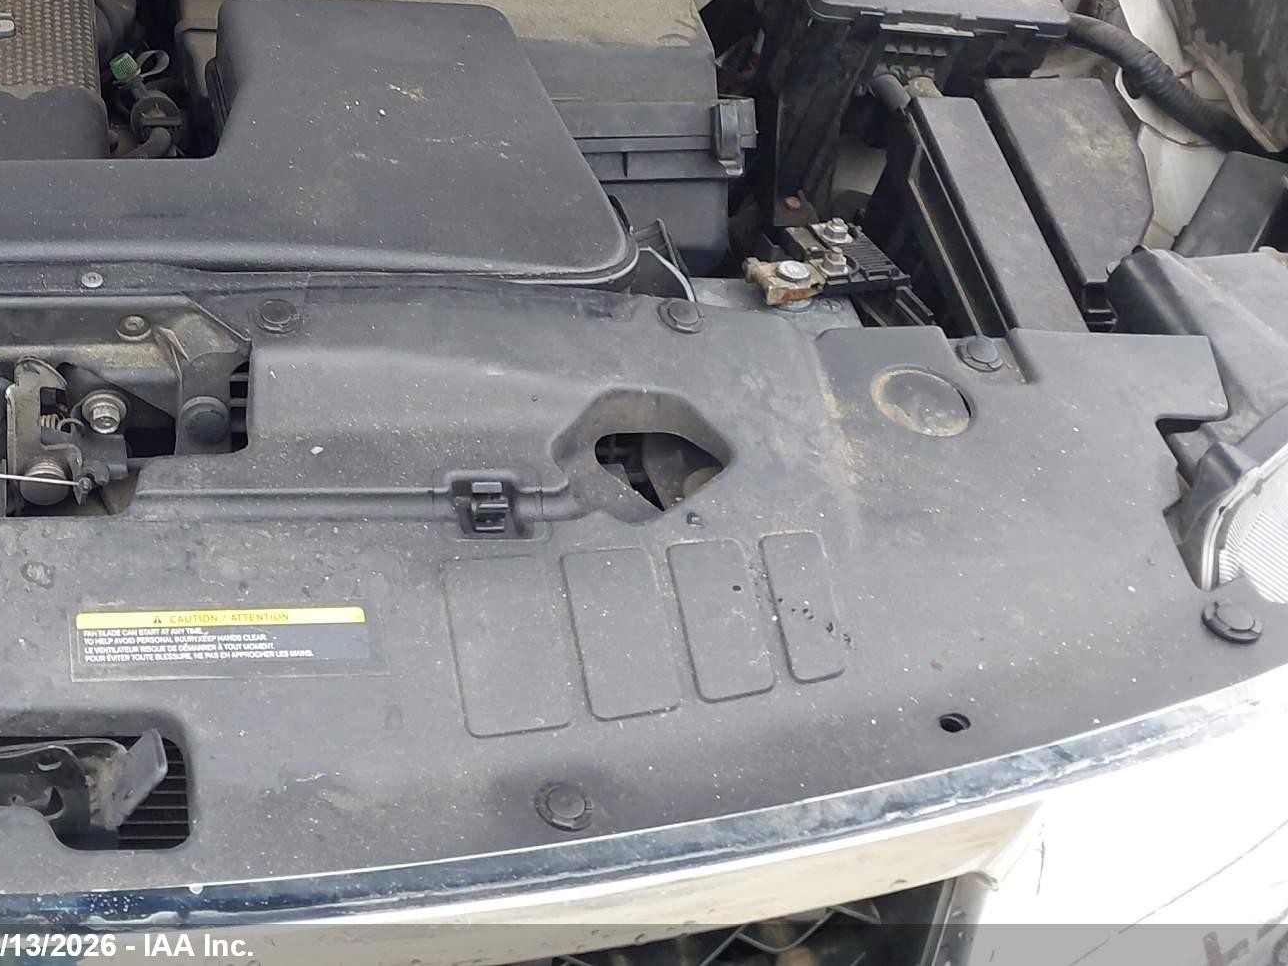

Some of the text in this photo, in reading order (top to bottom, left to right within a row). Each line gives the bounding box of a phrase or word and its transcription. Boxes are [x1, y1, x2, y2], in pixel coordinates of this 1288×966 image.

[168, 614, 218, 623] CAUTION
[231, 612, 289, 622] ATTENTION
[83, 629, 98, 637] FAN
[122, 628, 138, 636] CAN
[139, 628, 160, 636] START
[161, 627, 170, 635] AT
[171, 627, 186, 635] ANY
[84, 637, 95, 645] TO
[95, 637, 114, 645] HELP
[114, 636, 136, 644] AVOID
[136, 635, 174, 644] PERSONAL
[217, 634, 242, 642] HANDS
[84, 646, 94, 654] LE
[94, 645, 139, 654] VENTILATEUR
[140, 645, 166, 653] RISQUE
[167, 644, 177, 652] DE
[223, 642, 242, 651] TOUT
[85, 654, 107, 662] POUR
[132, 653, 154, 661] TOUTE
[193, 652, 204, 660] NE
[204, 651, 220, 659] PAS
[220, 651, 231, 659] EN
[232, 650, 275, 658] APPROCHER
[275, 650, 289, 658] LES
